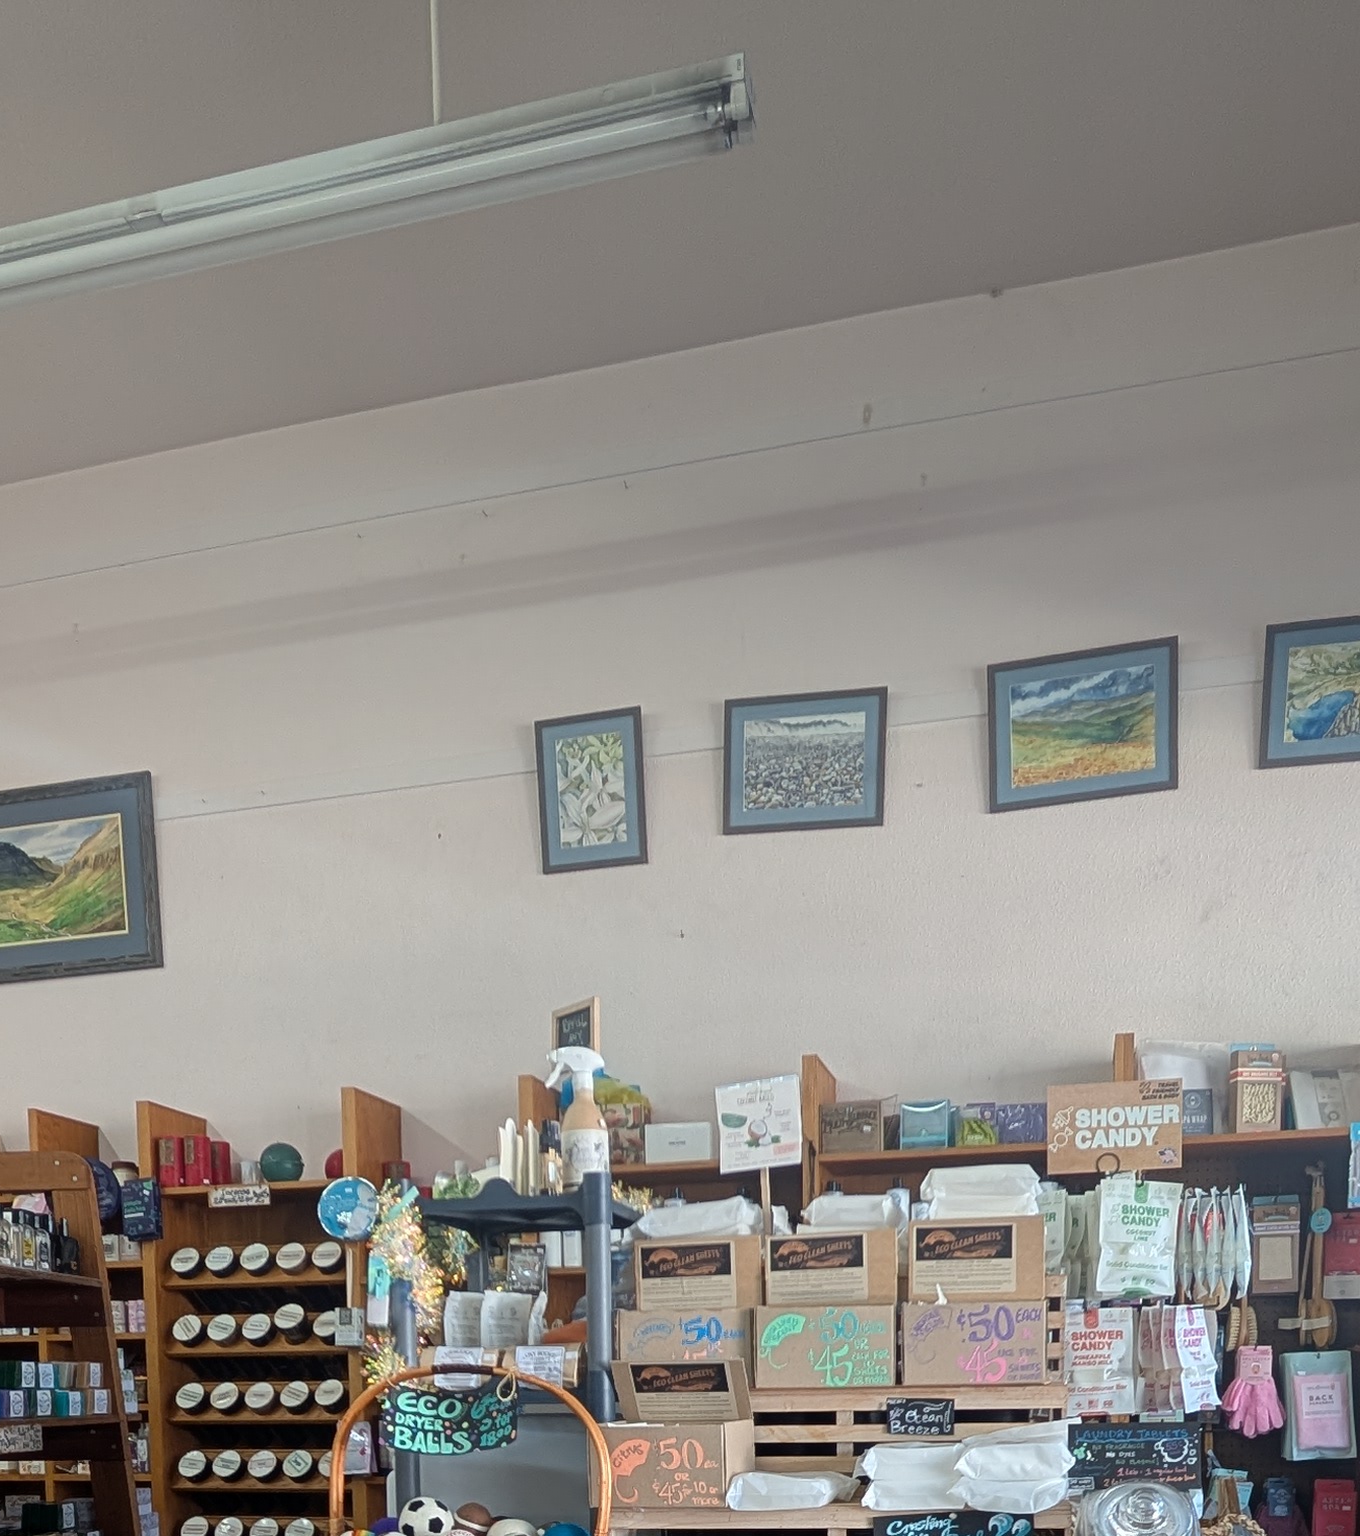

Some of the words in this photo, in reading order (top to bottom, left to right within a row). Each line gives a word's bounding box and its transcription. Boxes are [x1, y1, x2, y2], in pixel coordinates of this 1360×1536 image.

[1075, 1104, 1180, 1128] SHOWER
[1075, 1126, 1157, 1149] CANDY
[1121, 1204, 1170, 1216] SHOWER
[1121, 1215, 1160, 1227] CANDY
[790, 1252, 805, 1264] ECO
[804, 1246, 826, 1260] CLEAN
[825, 1240, 854, 1254] SHEETS
[935, 1243, 950, 1254] ECO
[950, 1234, 974, 1249] CLEAN
[974, 1231, 1002, 1244] SHEETS
[659, 1261, 674, 1273] ECO
[674, 1253, 696, 1268] CLEAN
[695, 1248, 721, 1261] SHEETS
[1124, 1261, 1158, 1270] Conditioner
[679, 1315, 723, 1345] $50
[956, 1304, 1015, 1343] $50
[1015, 1307, 1042, 1323] EACH
[1071, 1330, 1124, 1341] SHOWER
[1071, 1341, 1112, 1351] CANDY
[808, 1344, 853, 1386] $45
[957, 1339, 1007, 1383] $45
[653, 1378, 667, 1388] ECO
[667, 1372, 689, 1384] CLEAN
[689, 1368, 716, 1378] SHEETS
[1077, 1384, 1114, 1393] Conditioner
[397, 1392, 462, 1418] ECO
[395, 1412, 444, 1431] DRYER
[890, 1419, 940, 1435] Breeze
[905, 1410, 943, 1424] Ocean
[394, 1425, 472, 1454] BALLS
[1075, 1430, 1132, 1442] LAUNDRY
[1137, 1429, 1188, 1439] TABLETS
[612, 1443, 644, 1468] Citrus
[654, 1437, 704, 1470] $50
[652, 1479, 683, 1505] $45
[693, 1481, 707, 1494] 10
[691, 1497, 720, 1505] more
[886, 1515, 958, 1536] Crashing
